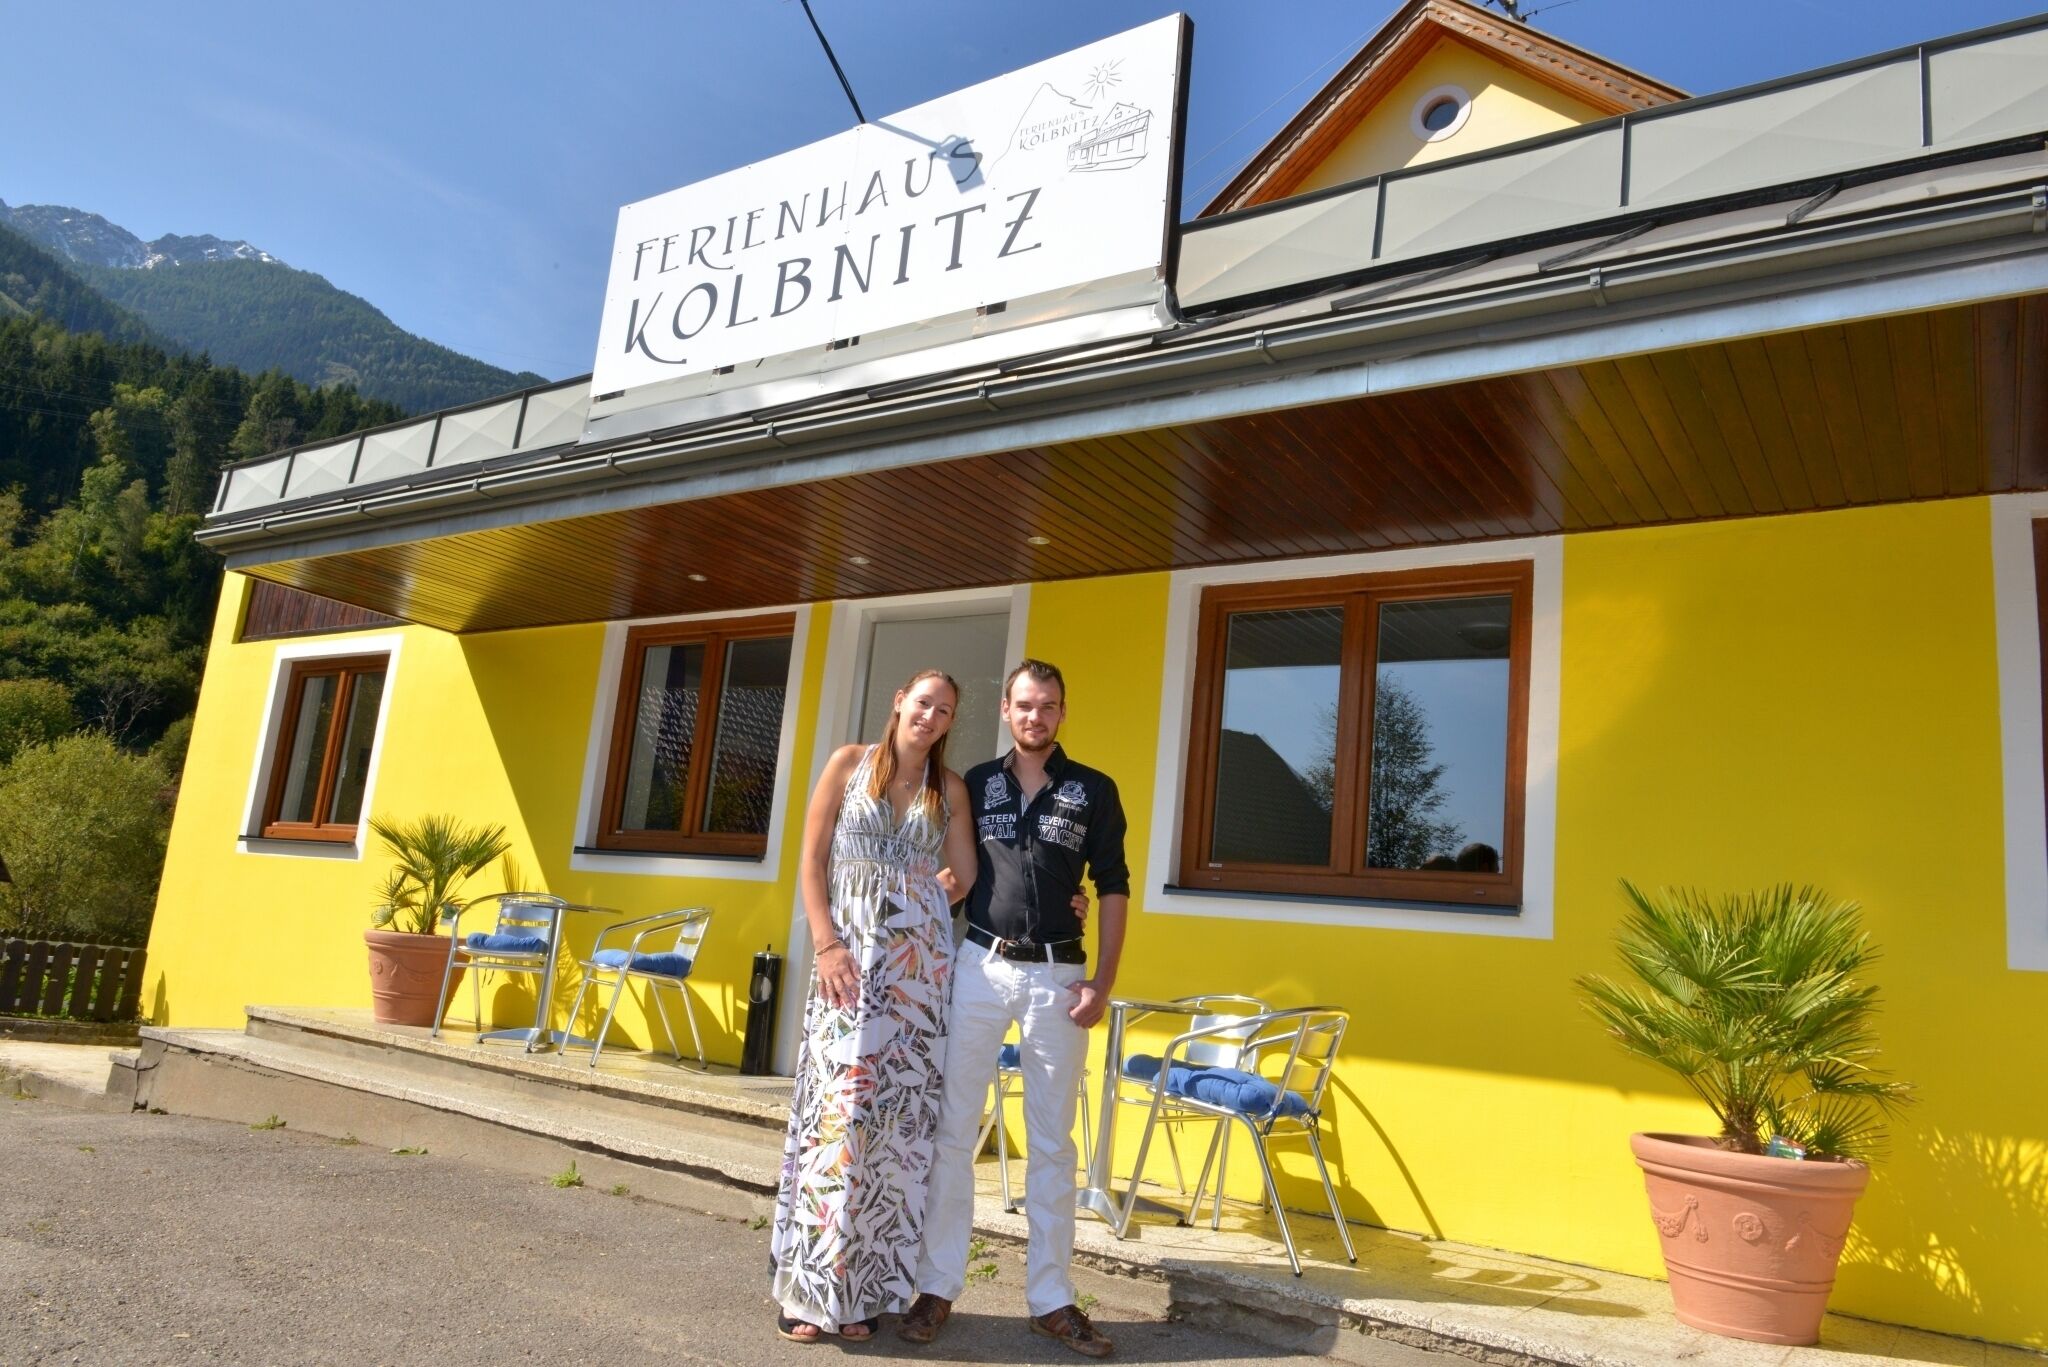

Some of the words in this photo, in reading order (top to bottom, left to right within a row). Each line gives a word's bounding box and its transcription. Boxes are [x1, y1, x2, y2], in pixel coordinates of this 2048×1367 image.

[1019, 115, 1099, 151] KOLBNITZ
[632, 138, 982, 281] FERIENHAUS
[624, 187, 1042, 365] KOLBNITZ
[1038, 814, 1074, 830] SEVENTY
